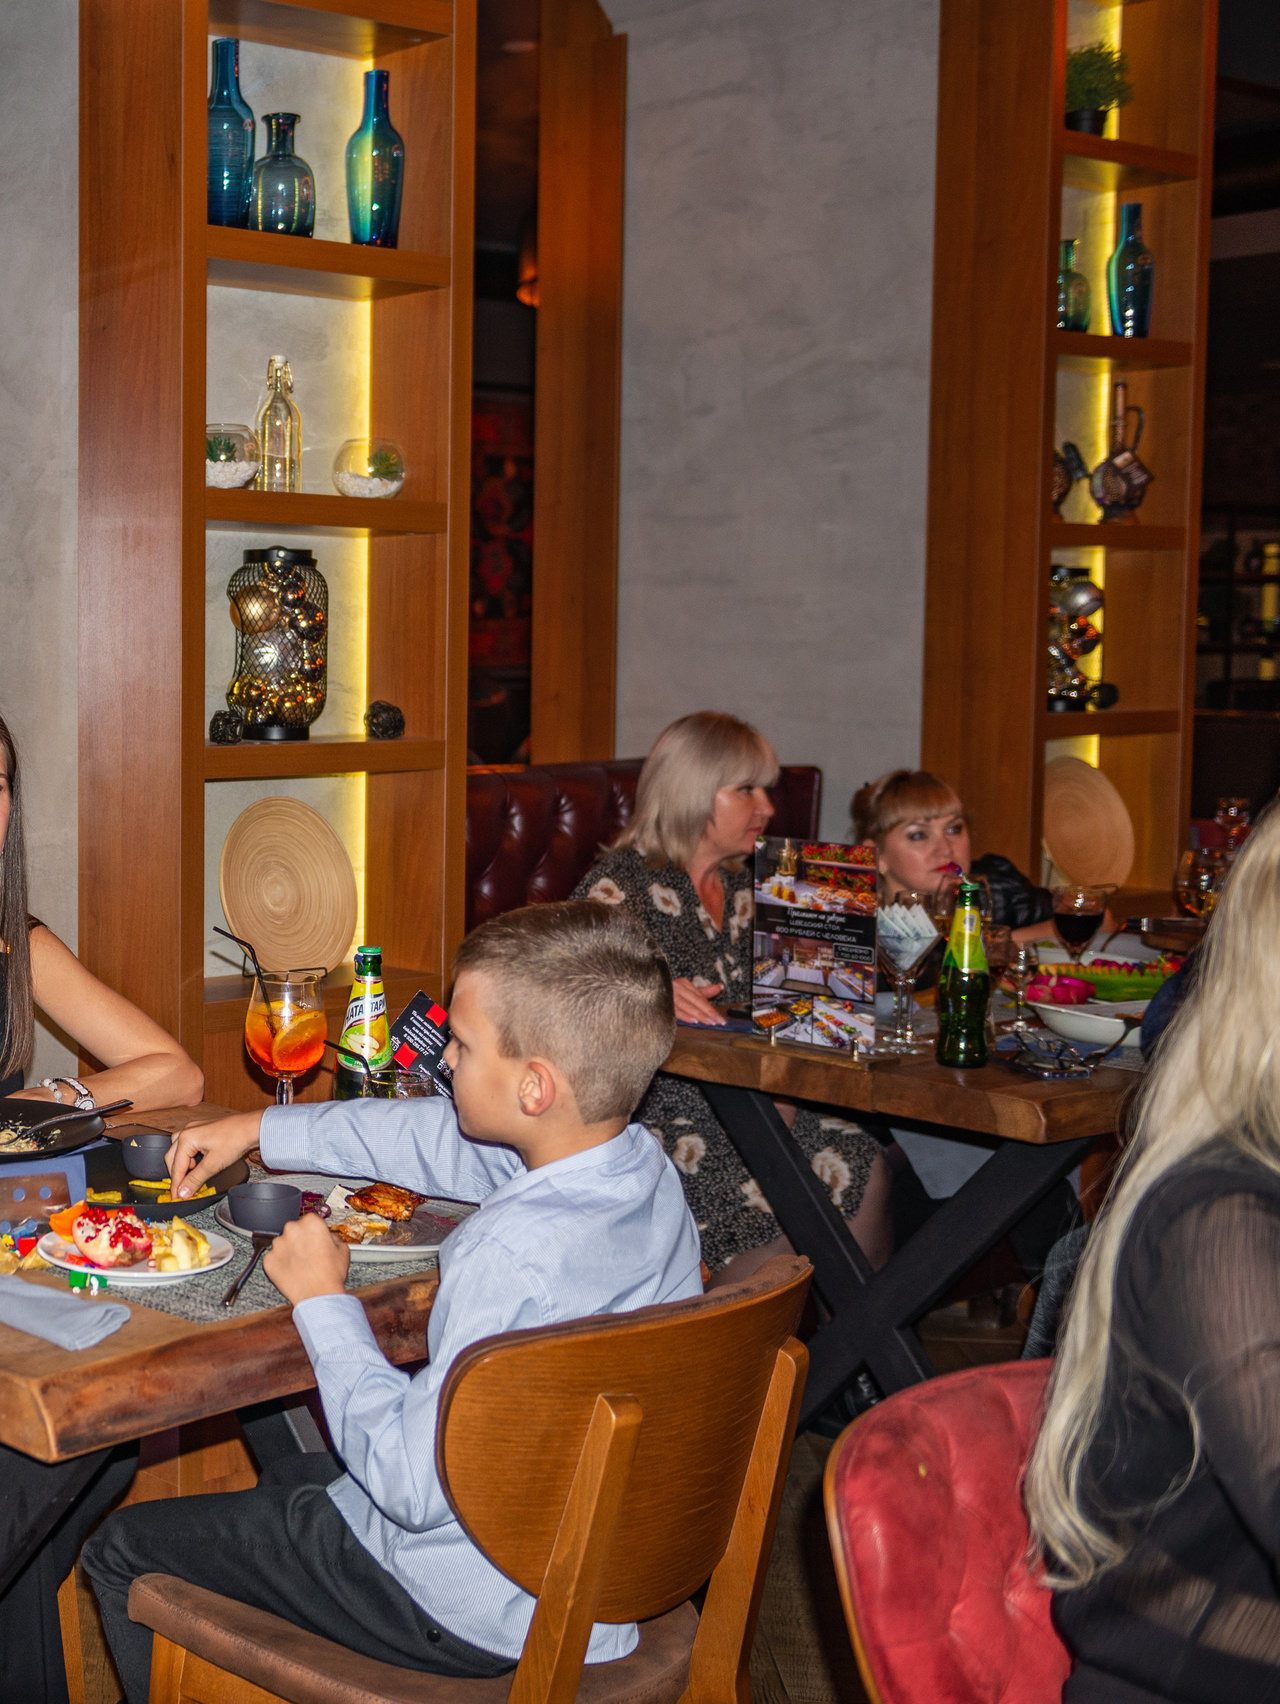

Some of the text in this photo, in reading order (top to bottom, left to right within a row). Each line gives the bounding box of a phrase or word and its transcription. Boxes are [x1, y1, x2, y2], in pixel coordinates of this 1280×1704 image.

[789, 920, 841, 931] ШВЕДСКИЙ СТОЛ
[790, 928, 815, 938] РУБЛЕЙ
[822, 932, 857, 943] ЧЕЛОВЕКА
[345, 998, 384, 1027] НАТАТАРИ
